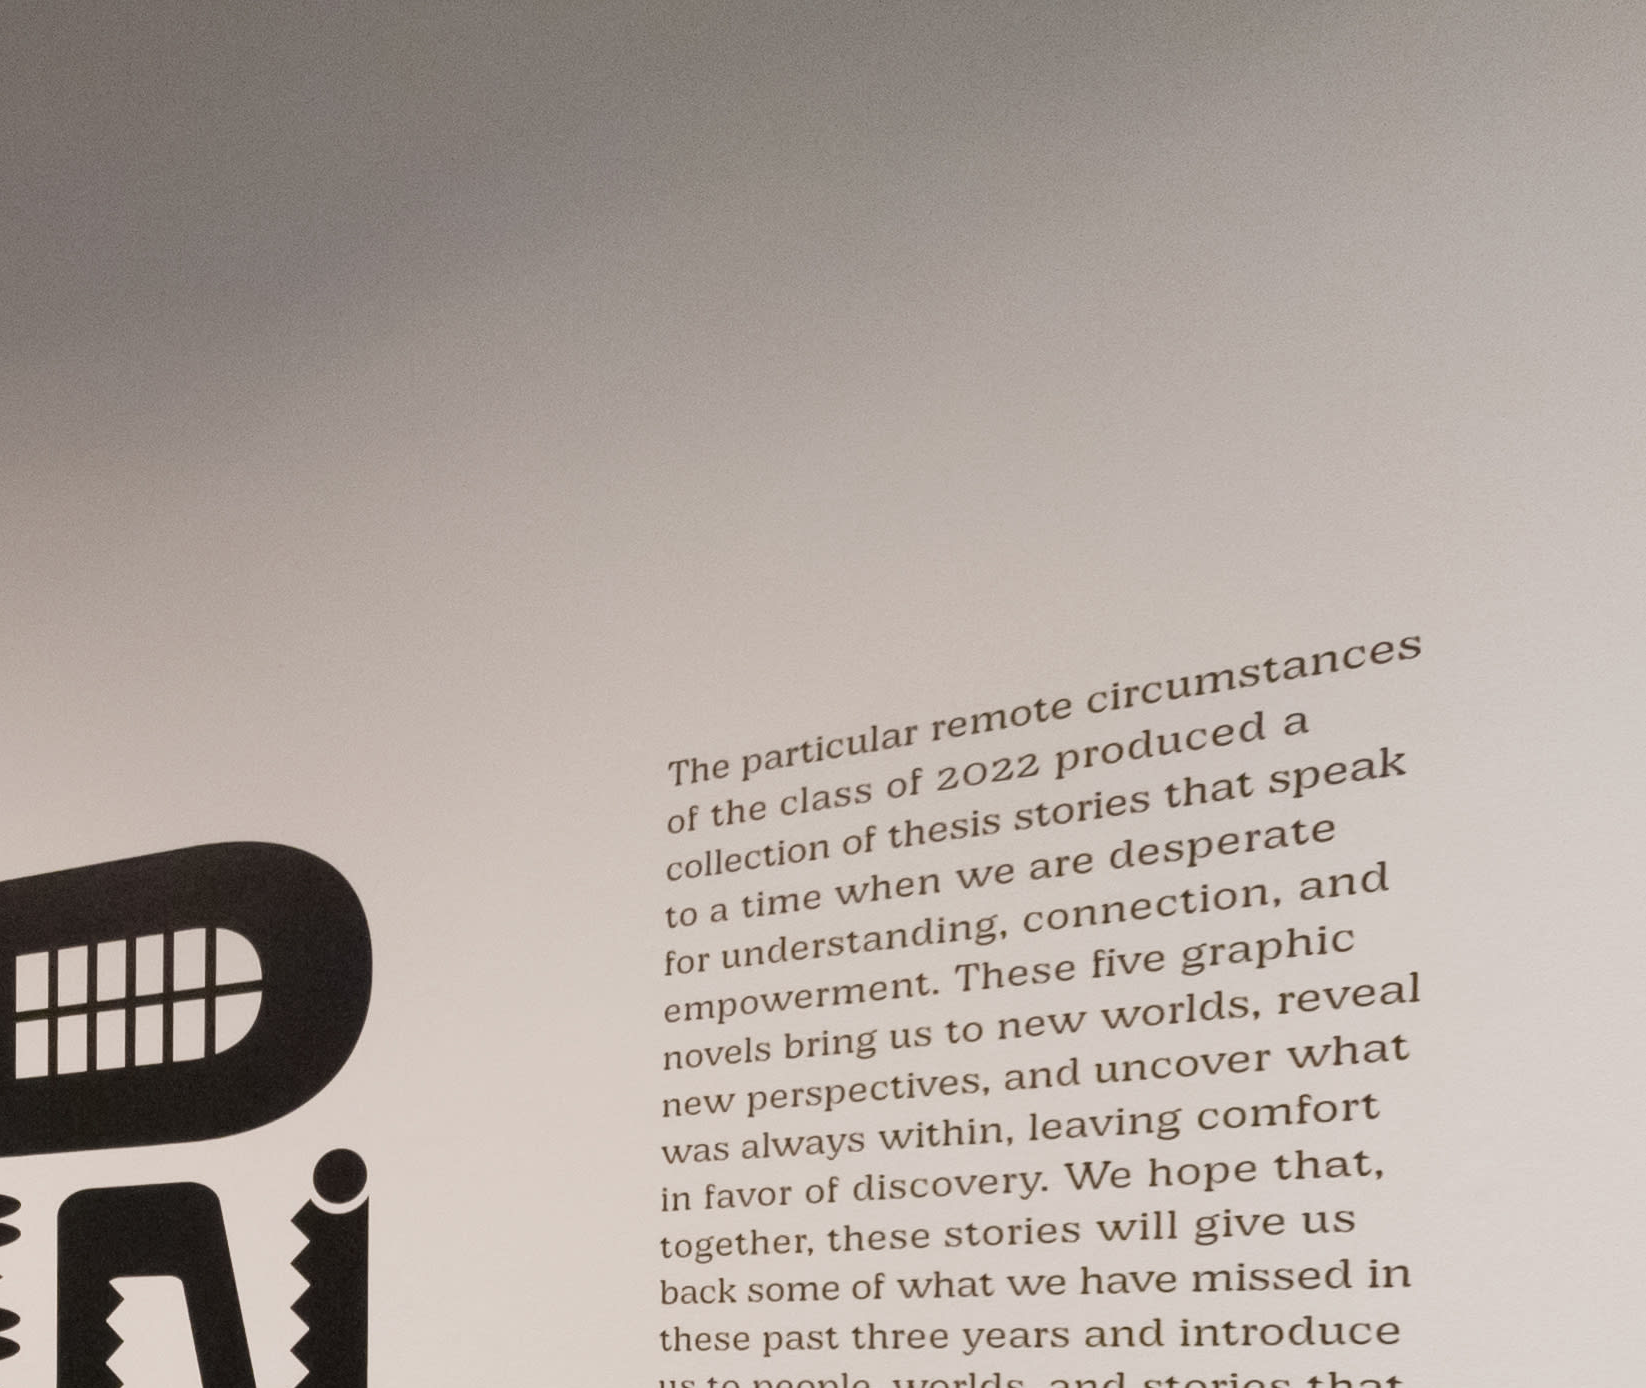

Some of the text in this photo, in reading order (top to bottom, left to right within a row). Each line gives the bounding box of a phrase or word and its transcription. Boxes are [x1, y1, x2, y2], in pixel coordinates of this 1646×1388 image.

[667, 635, 1422, 787] The particular remote circumstances
[666, 710, 1310, 835] of the class of 2022 produced a
[666, 746, 1408, 882] collection of thesis stories that speak
[664, 819, 1336, 929] to a time when we are desperate
[664, 860, 1390, 977] for understanding, connection, and
[663, 925, 1355, 1025] empowerment. These five graphic
[663, 970, 1421, 1072] novels bring us to new worlds, reveal
[662, 1033, 1411, 1119] new perspectives, and uncover what
[660, 1093, 1381, 1165] was always within, leaving comfort
[661, 1149, 1384, 1213] in favor of discovery. We hope that,
[659, 1208, 1356, 1265] together, these stories will give us
[659, 1257, 1412, 1306] back some of what we have missed in
[658, 1314, 1401, 1359] these past three years and introduce
